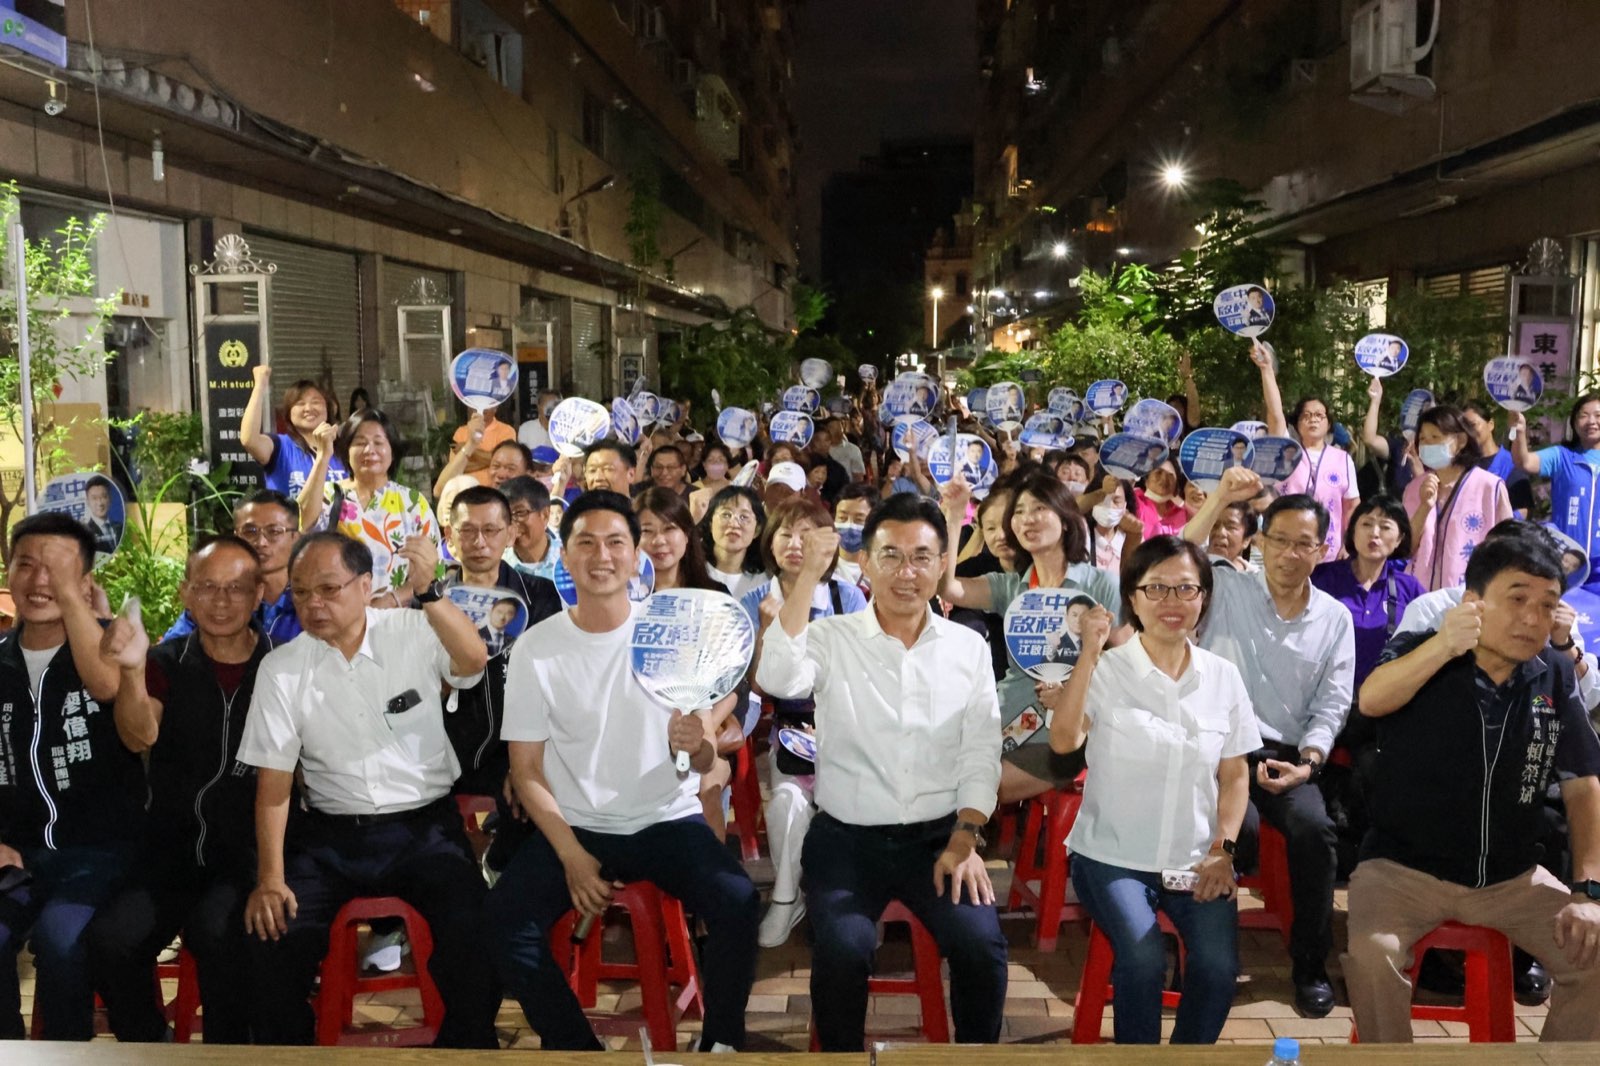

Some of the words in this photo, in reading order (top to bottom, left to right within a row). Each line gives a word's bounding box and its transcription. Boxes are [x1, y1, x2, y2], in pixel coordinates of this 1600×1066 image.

[230, 380, 254, 389] studi
[1019, 593, 1070, 611] 臺中
[1008, 615, 1064, 634] 啟程
[61, 690, 92, 764] 廖偉翔
[51, 746, 70, 792] 服務團隊
